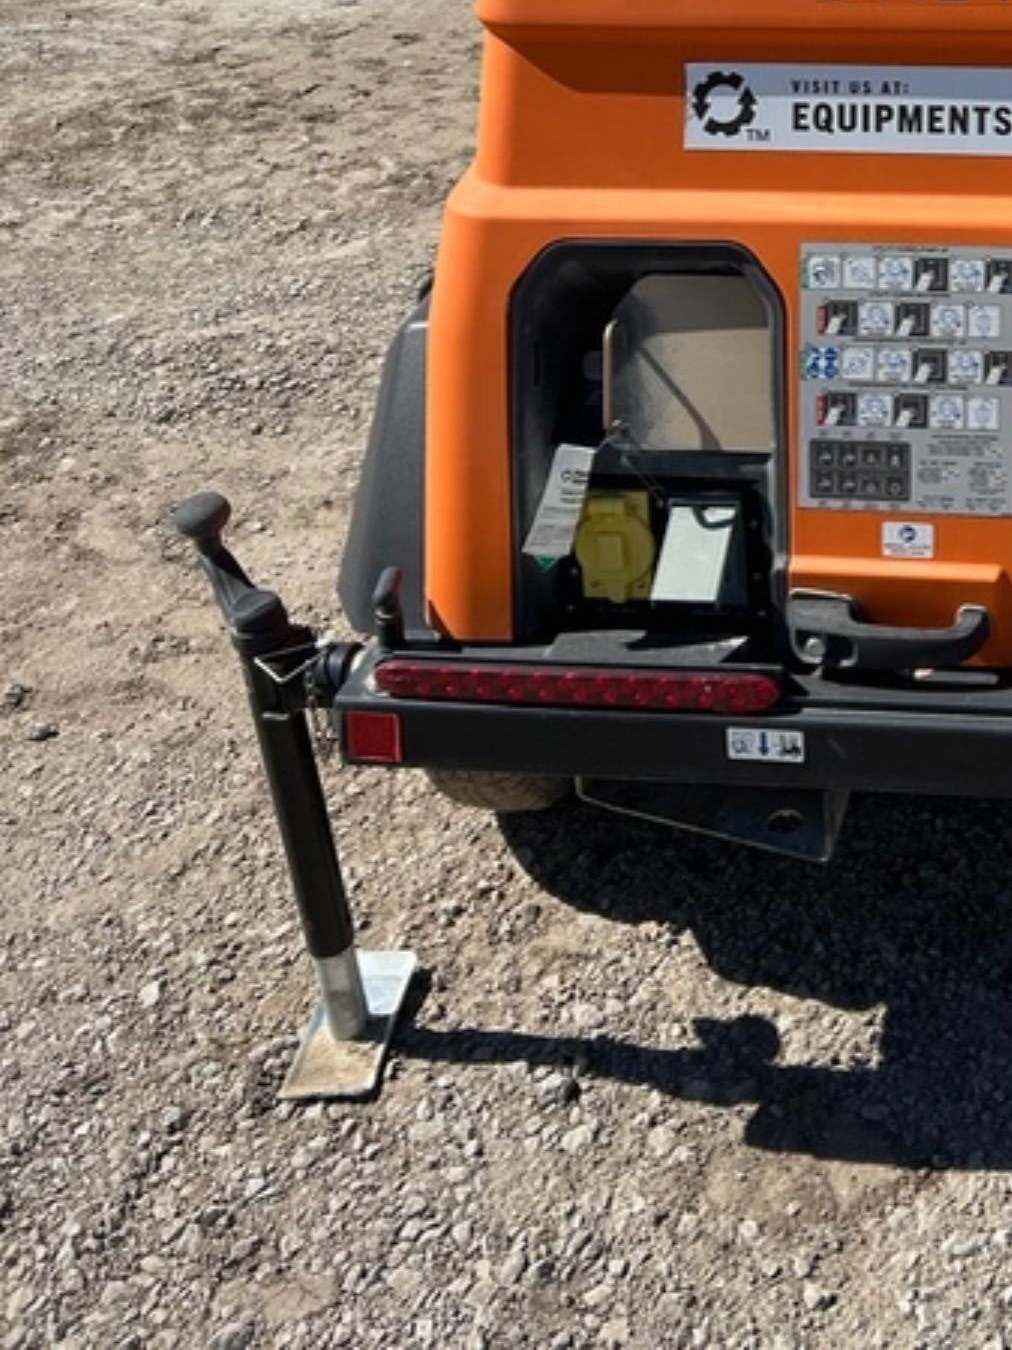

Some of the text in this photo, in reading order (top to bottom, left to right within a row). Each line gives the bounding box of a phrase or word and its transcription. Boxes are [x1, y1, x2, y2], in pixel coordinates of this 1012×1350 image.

[790, 79, 910, 97] VISIT US AT:
[746, 130, 771, 142] TM
